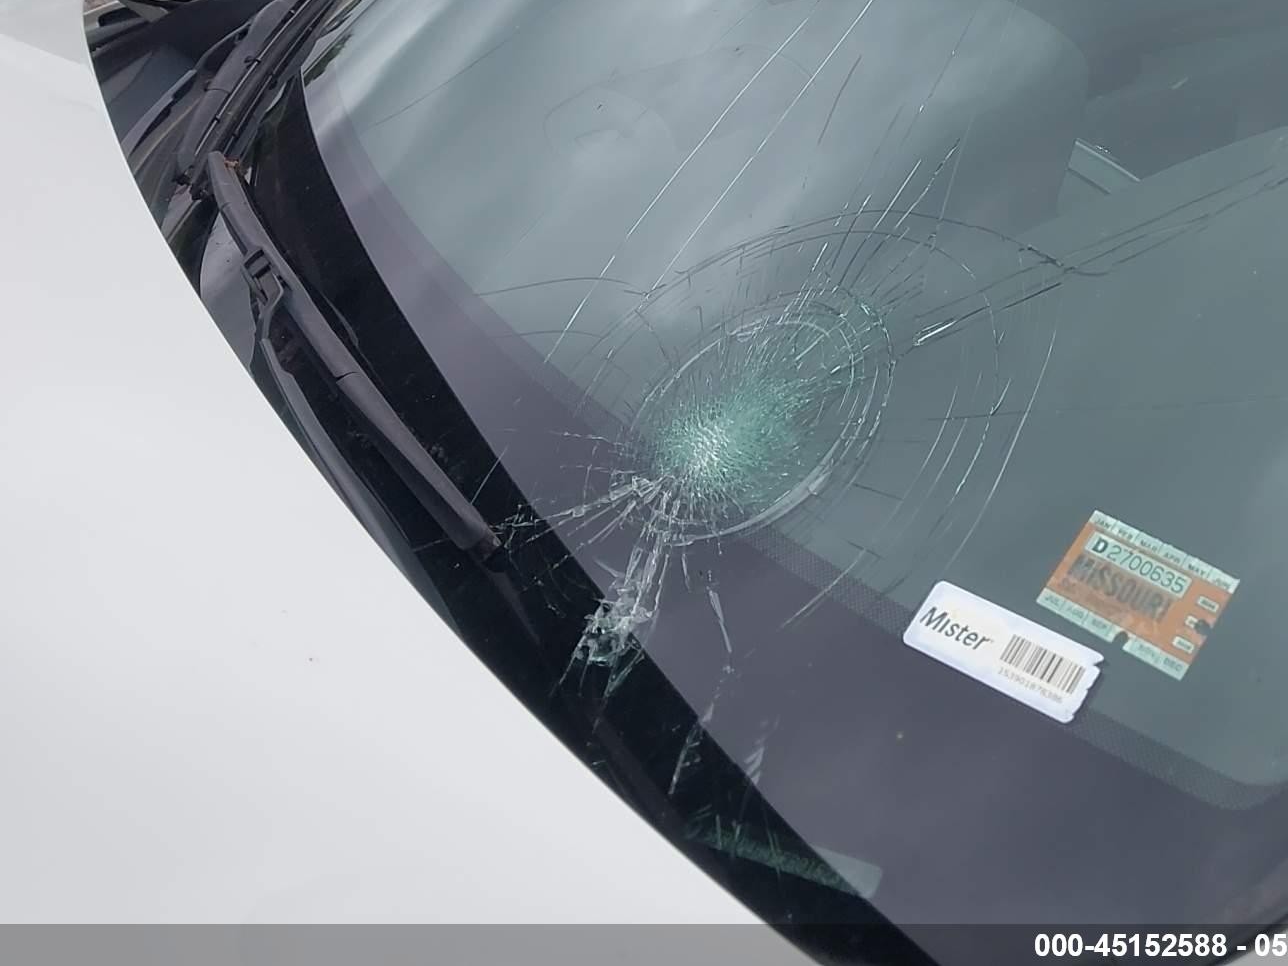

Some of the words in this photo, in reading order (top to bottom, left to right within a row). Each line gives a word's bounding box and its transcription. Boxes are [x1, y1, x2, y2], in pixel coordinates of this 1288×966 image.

[1068, 553, 1173, 622] MISSOURI
[1187, 563, 1206, 576] MAY
[919, 606, 990, 651] Mister
